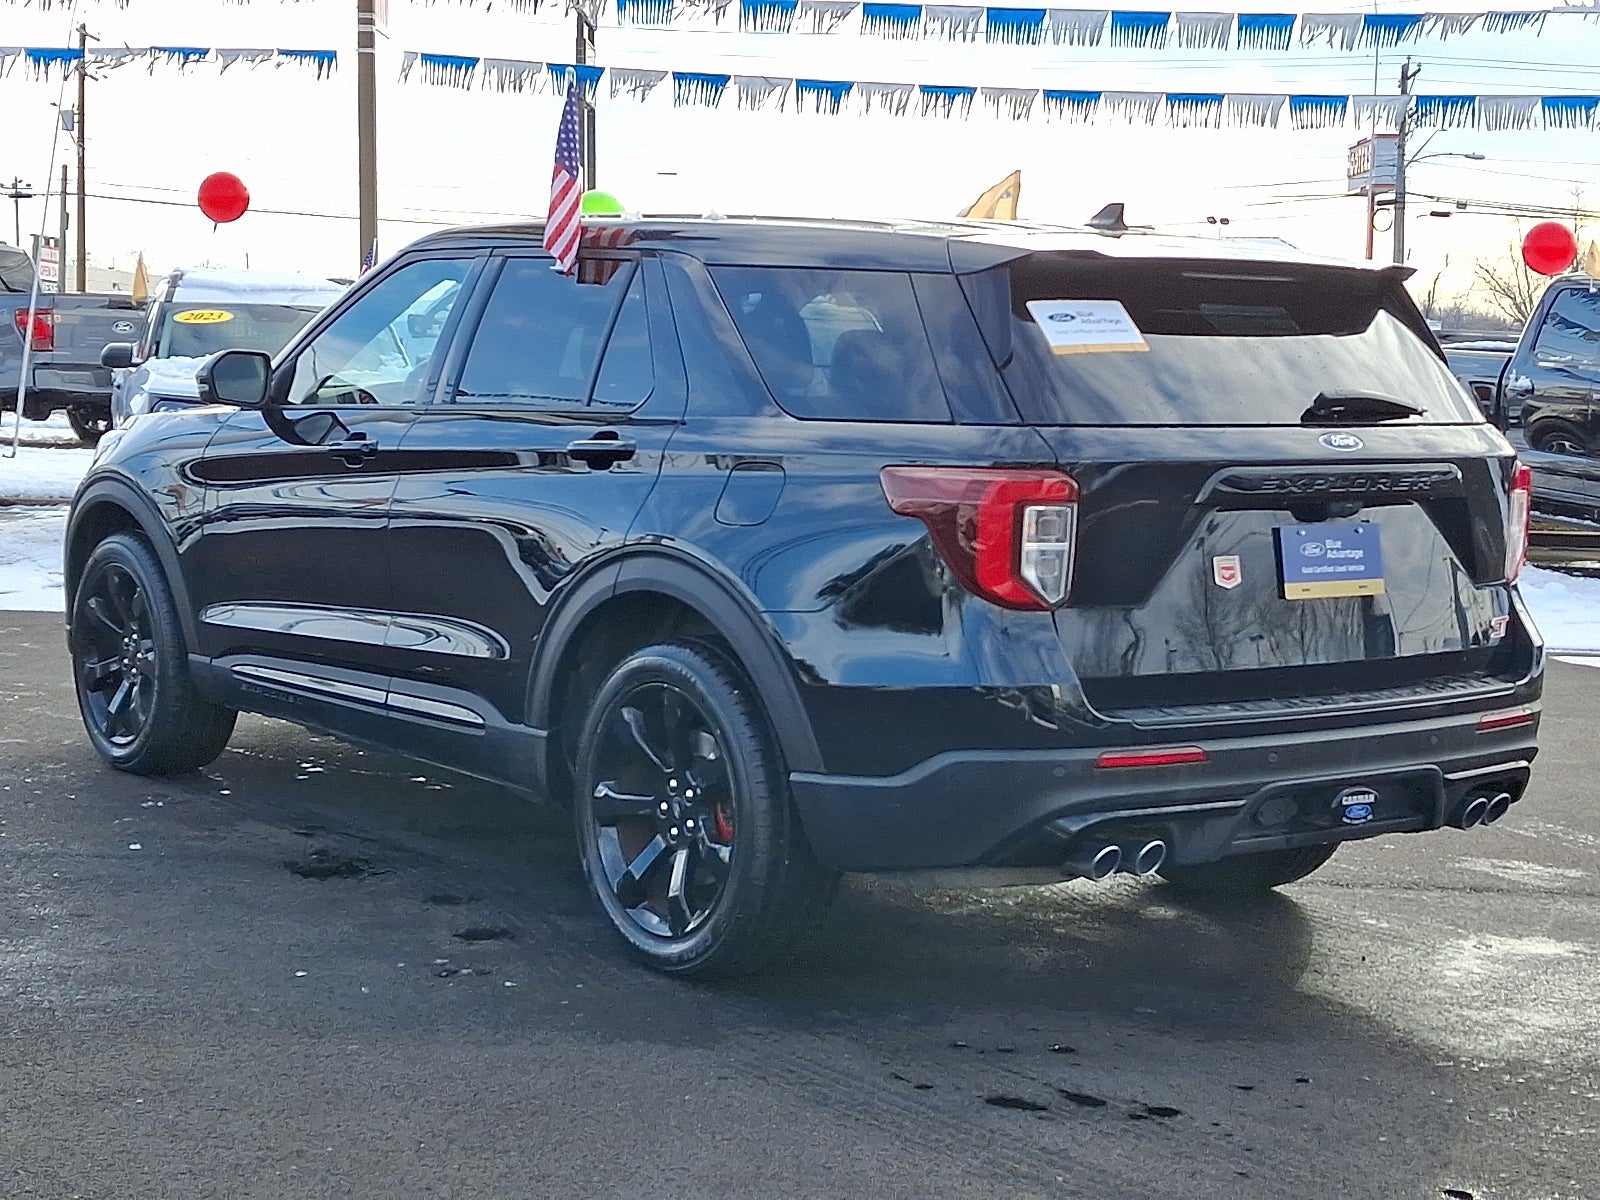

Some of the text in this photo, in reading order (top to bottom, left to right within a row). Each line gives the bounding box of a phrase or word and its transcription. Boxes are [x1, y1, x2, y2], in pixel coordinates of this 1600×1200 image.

[184, 312, 224, 320] 2023
[1262, 476, 1432, 493] EXPLORER
[1325, 539, 1342, 548] Blue
[1326, 549, 1364, 559] Advantage
[1491, 615, 1510, 638] ST
